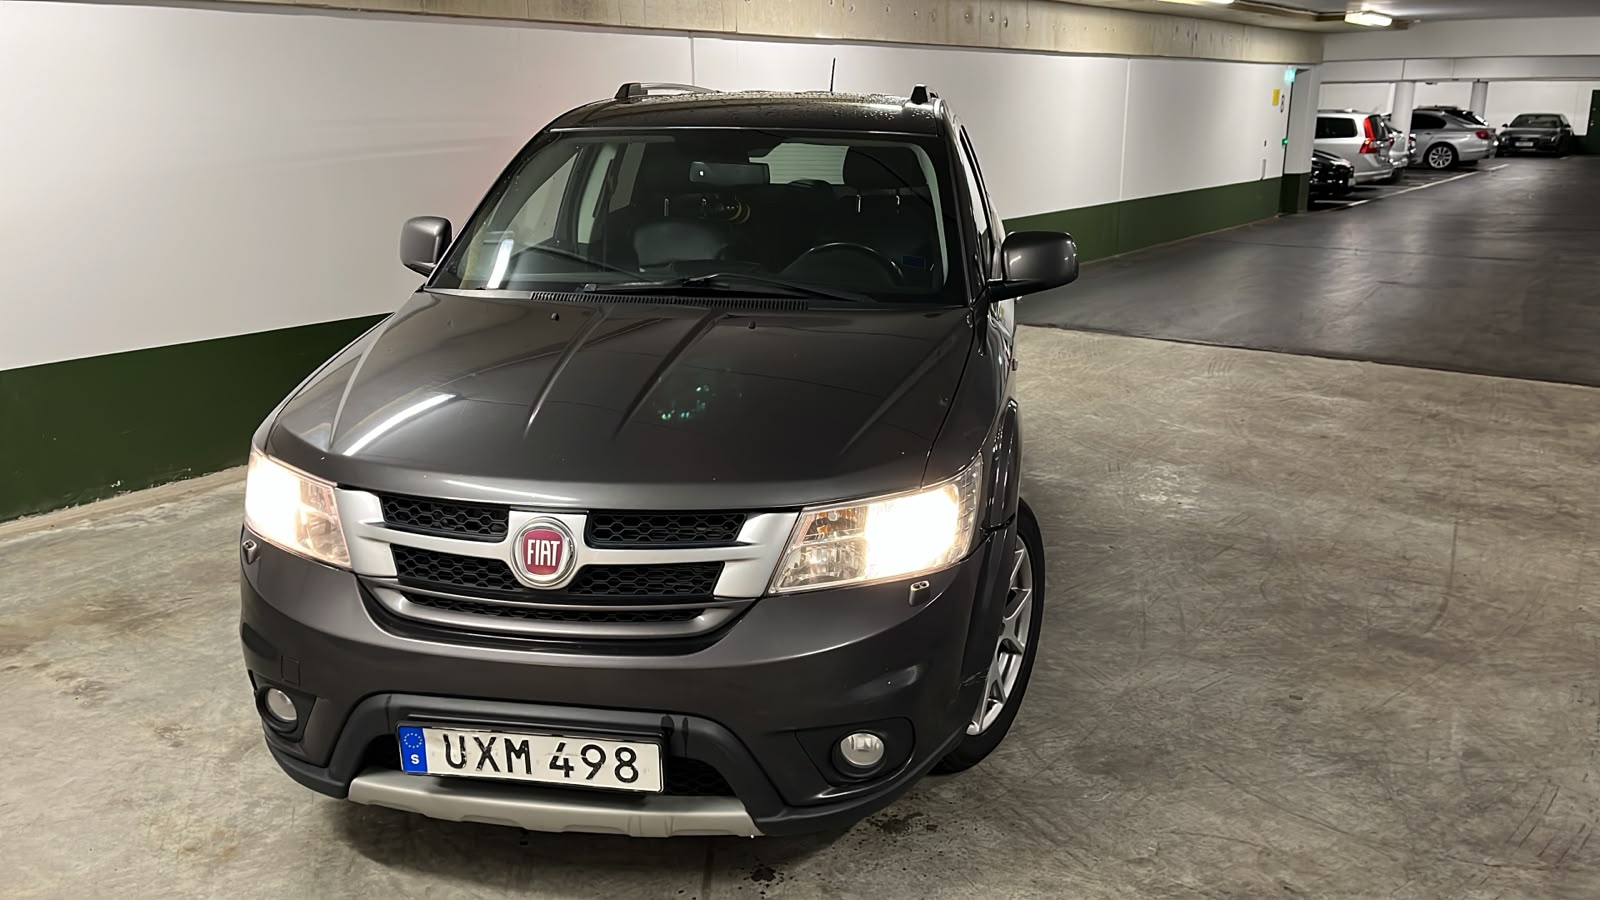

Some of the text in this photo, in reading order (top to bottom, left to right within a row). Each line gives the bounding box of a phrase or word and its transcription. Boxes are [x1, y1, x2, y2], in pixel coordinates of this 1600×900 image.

[527, 539, 561, 567] FIAT
[410, 753, 420, 765] S
[442, 733, 640, 784] UXM 498
